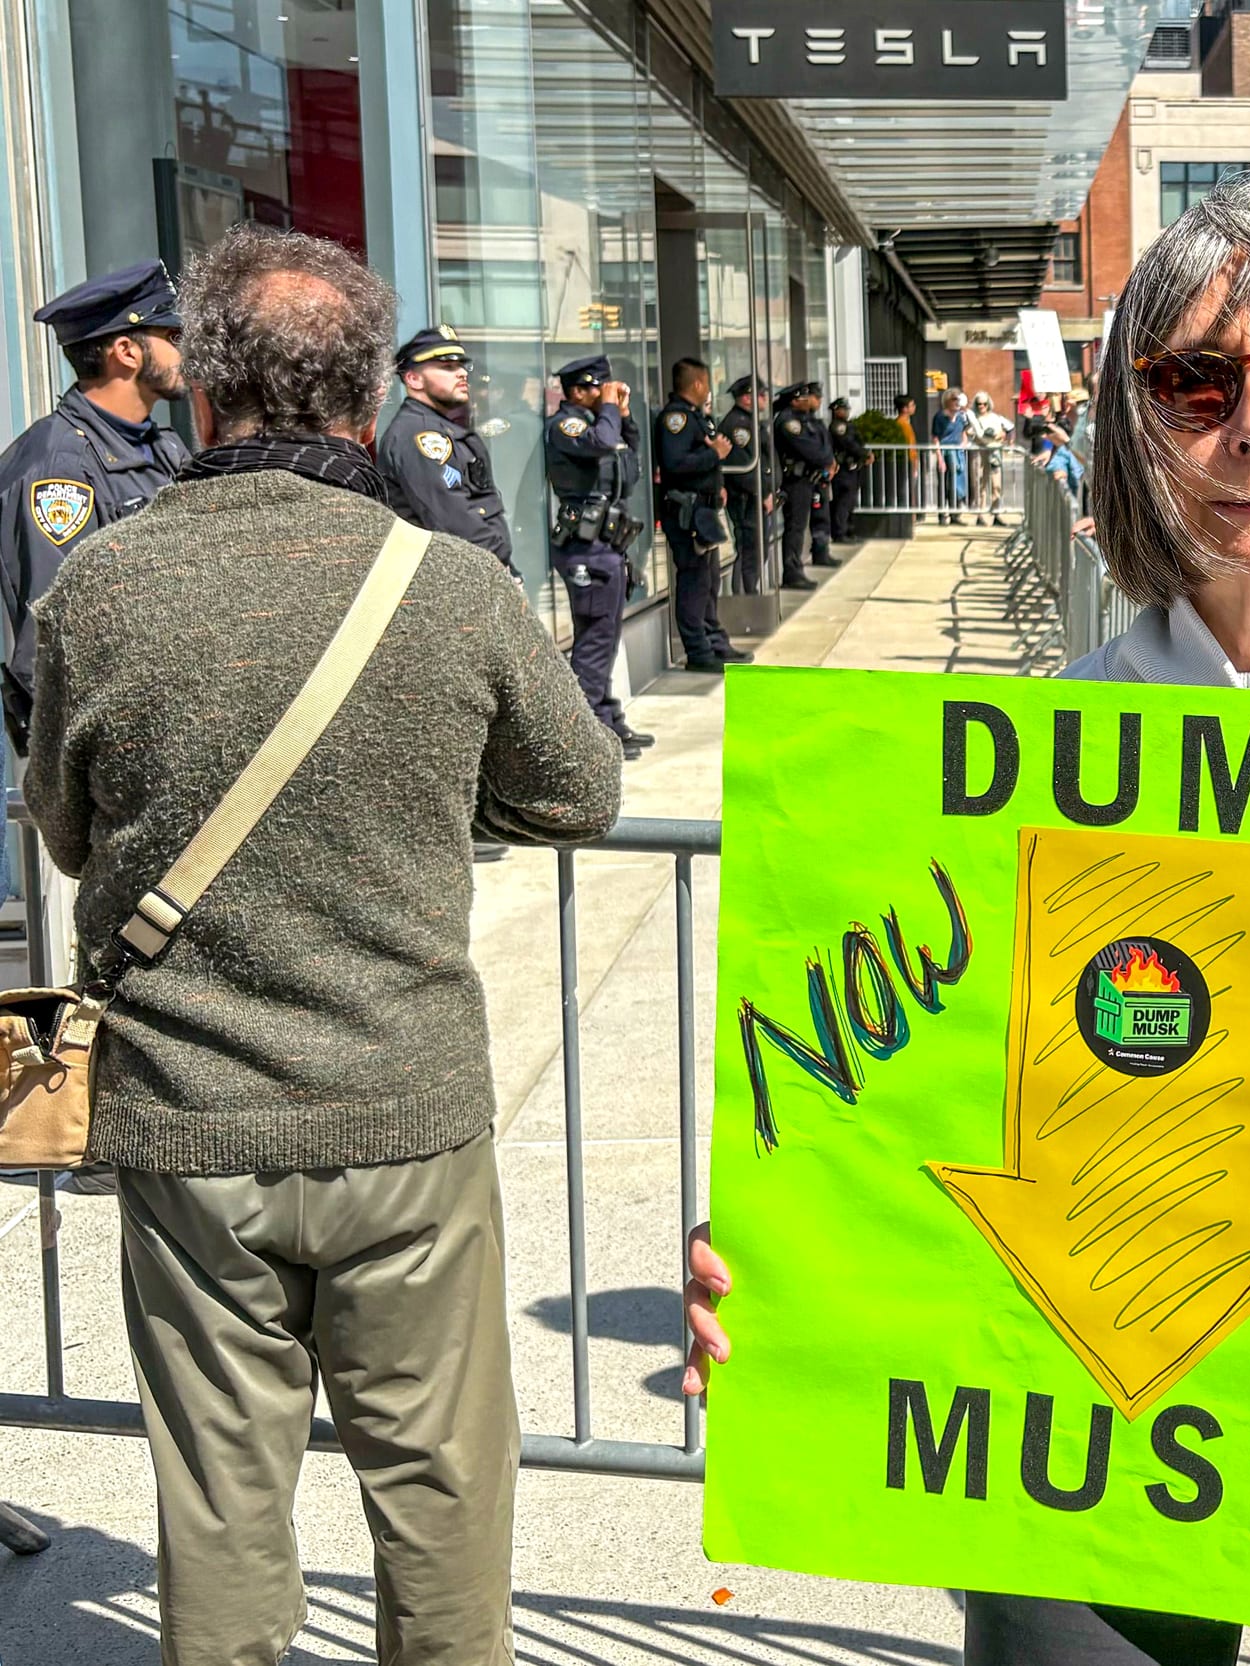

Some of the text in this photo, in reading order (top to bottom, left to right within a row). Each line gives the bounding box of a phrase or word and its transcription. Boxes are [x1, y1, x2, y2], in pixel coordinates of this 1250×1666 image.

[732, 28, 1047, 66] TESLA
[1133, 1009, 1180, 1022] DUMP
[1132, 1022, 1179, 1036] MUSK
[1115, 1050, 1145, 1060] Common
